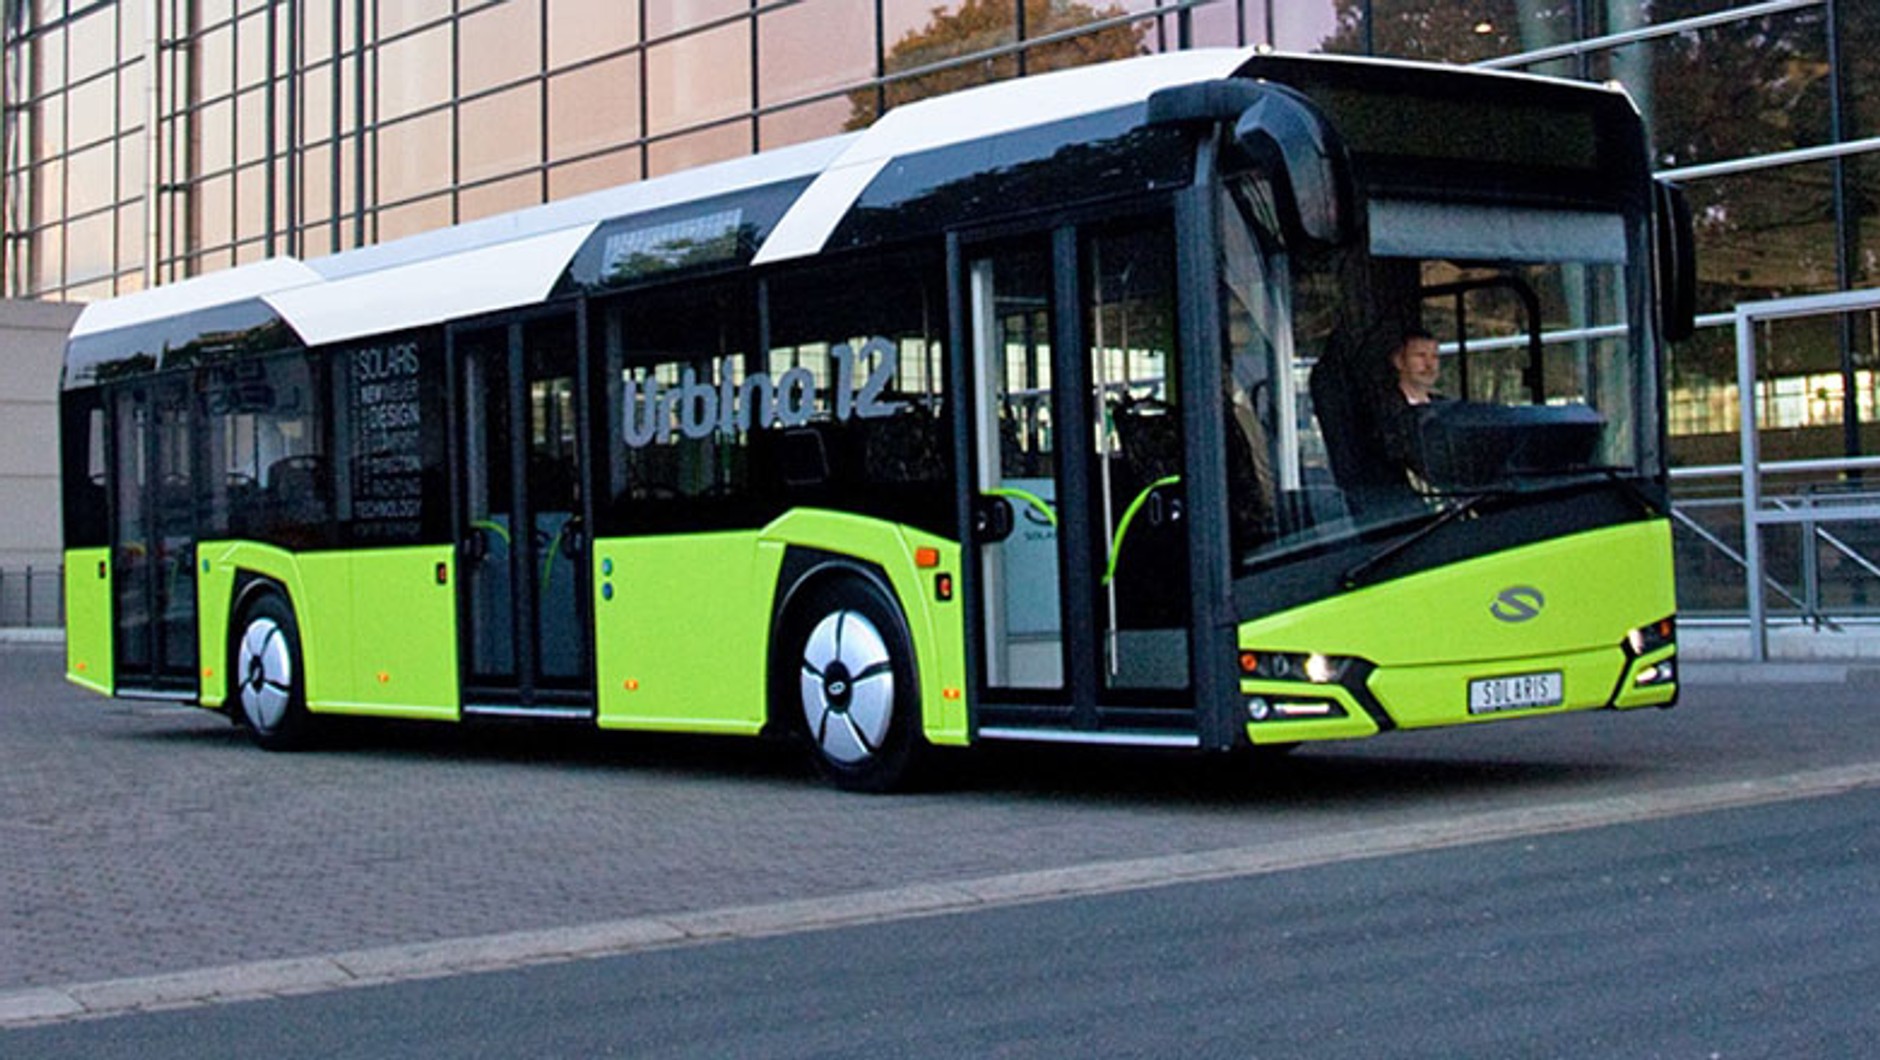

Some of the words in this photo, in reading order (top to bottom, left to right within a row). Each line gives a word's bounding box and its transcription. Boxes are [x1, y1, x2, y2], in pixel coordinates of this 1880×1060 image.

[359, 342, 420, 381] SOLARIS
[623, 354, 815, 448] Urbino
[831, 335, 909, 421] 12
[371, 402, 421, 430] DESIGN
[355, 499, 421, 518] TECHNOLOGY
[1483, 676, 1549, 704] SOLARIS
